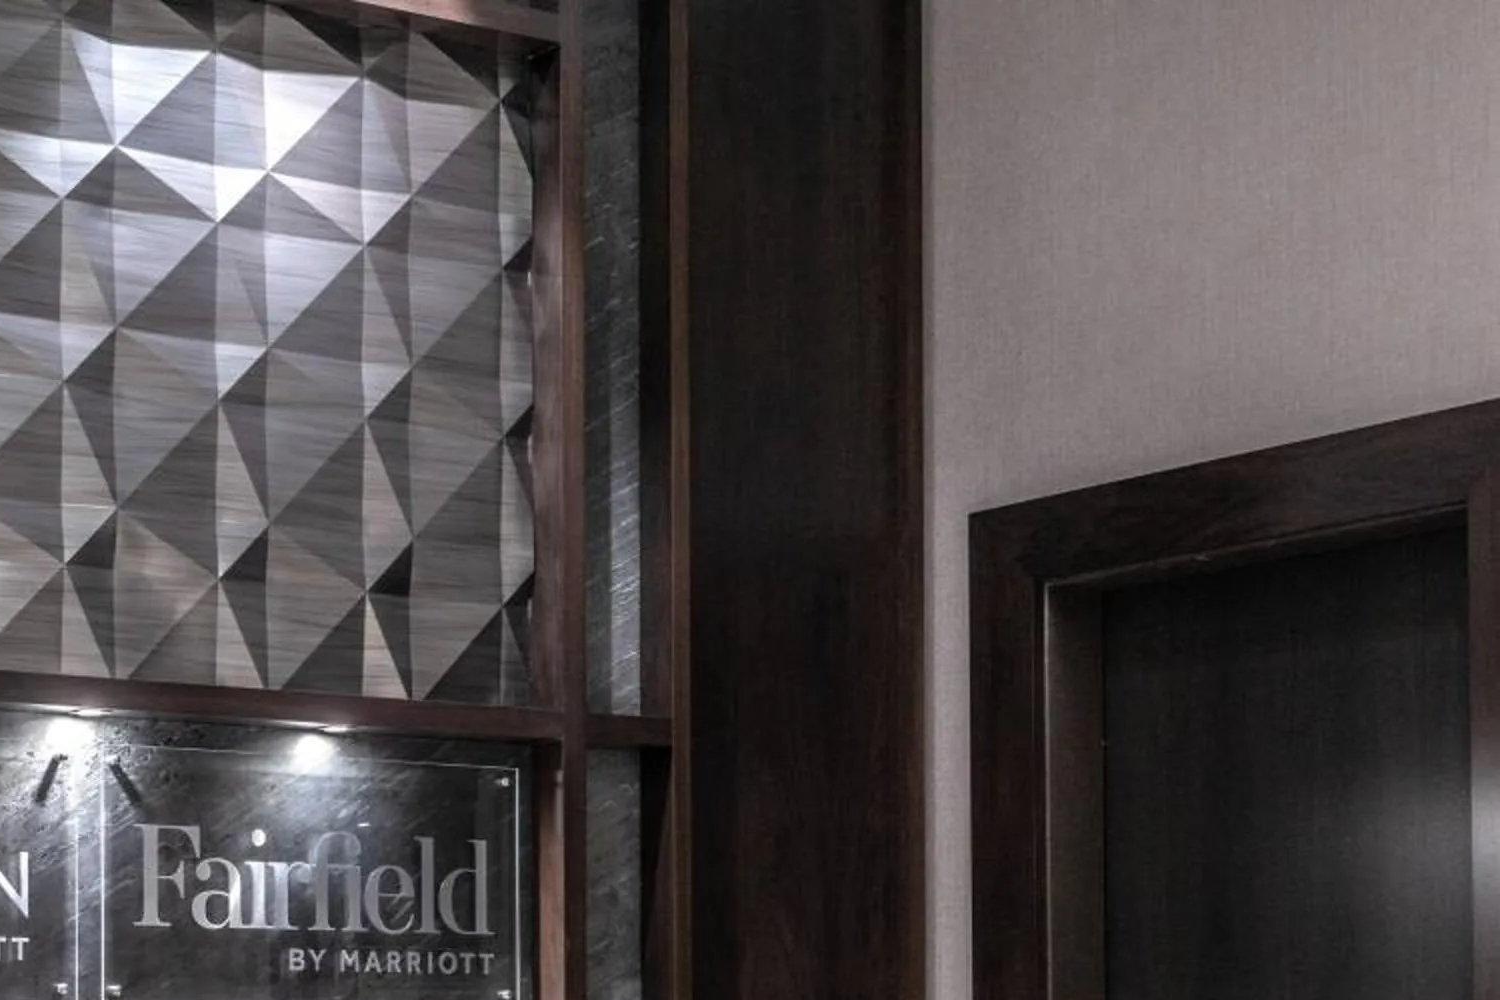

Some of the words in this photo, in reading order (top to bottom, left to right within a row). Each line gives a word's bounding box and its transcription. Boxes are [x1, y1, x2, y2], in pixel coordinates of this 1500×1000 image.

[133, 823, 496, 937] Fairfield
[288, 948, 325, 972] BY
[339, 949, 496, 976] MARRIOTT
